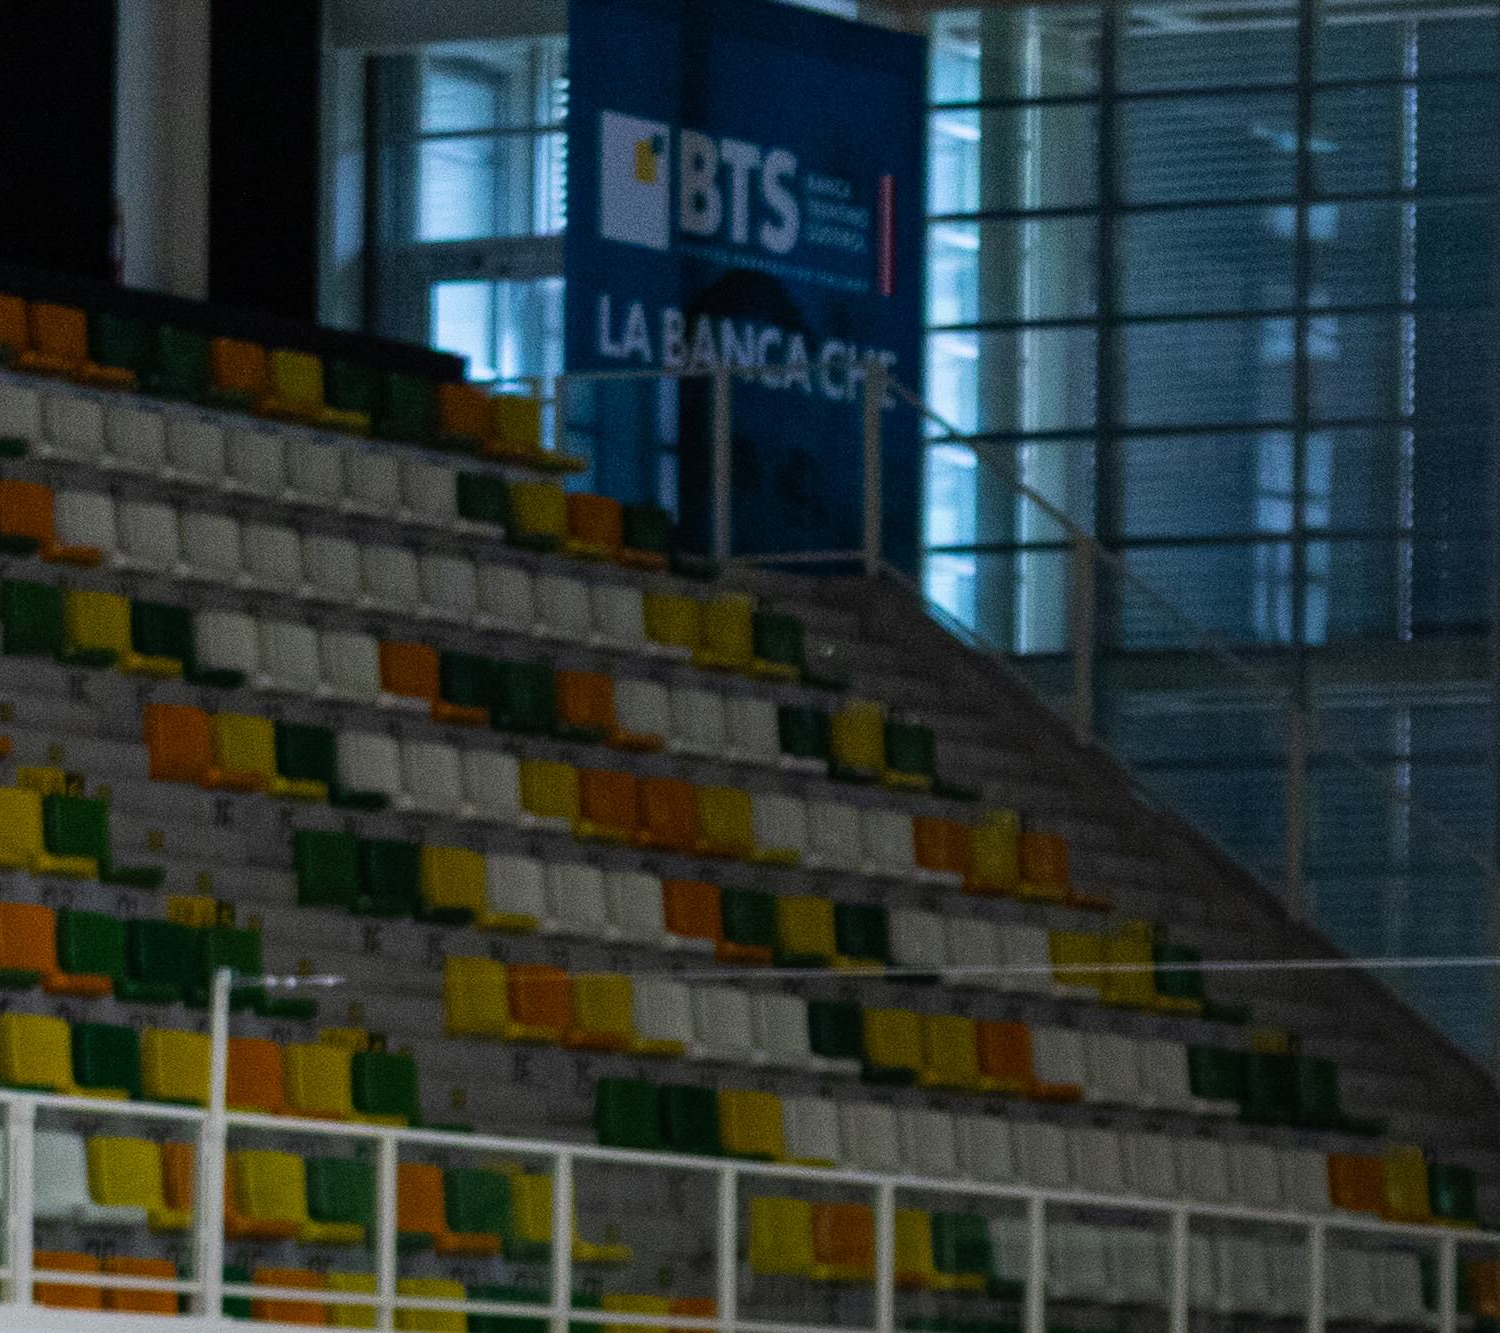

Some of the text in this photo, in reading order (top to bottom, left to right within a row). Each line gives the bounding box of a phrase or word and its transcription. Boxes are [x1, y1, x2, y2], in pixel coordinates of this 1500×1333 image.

[679, 128, 800, 254] BTS
[600, 295, 898, 410] LA BANCA CHE
